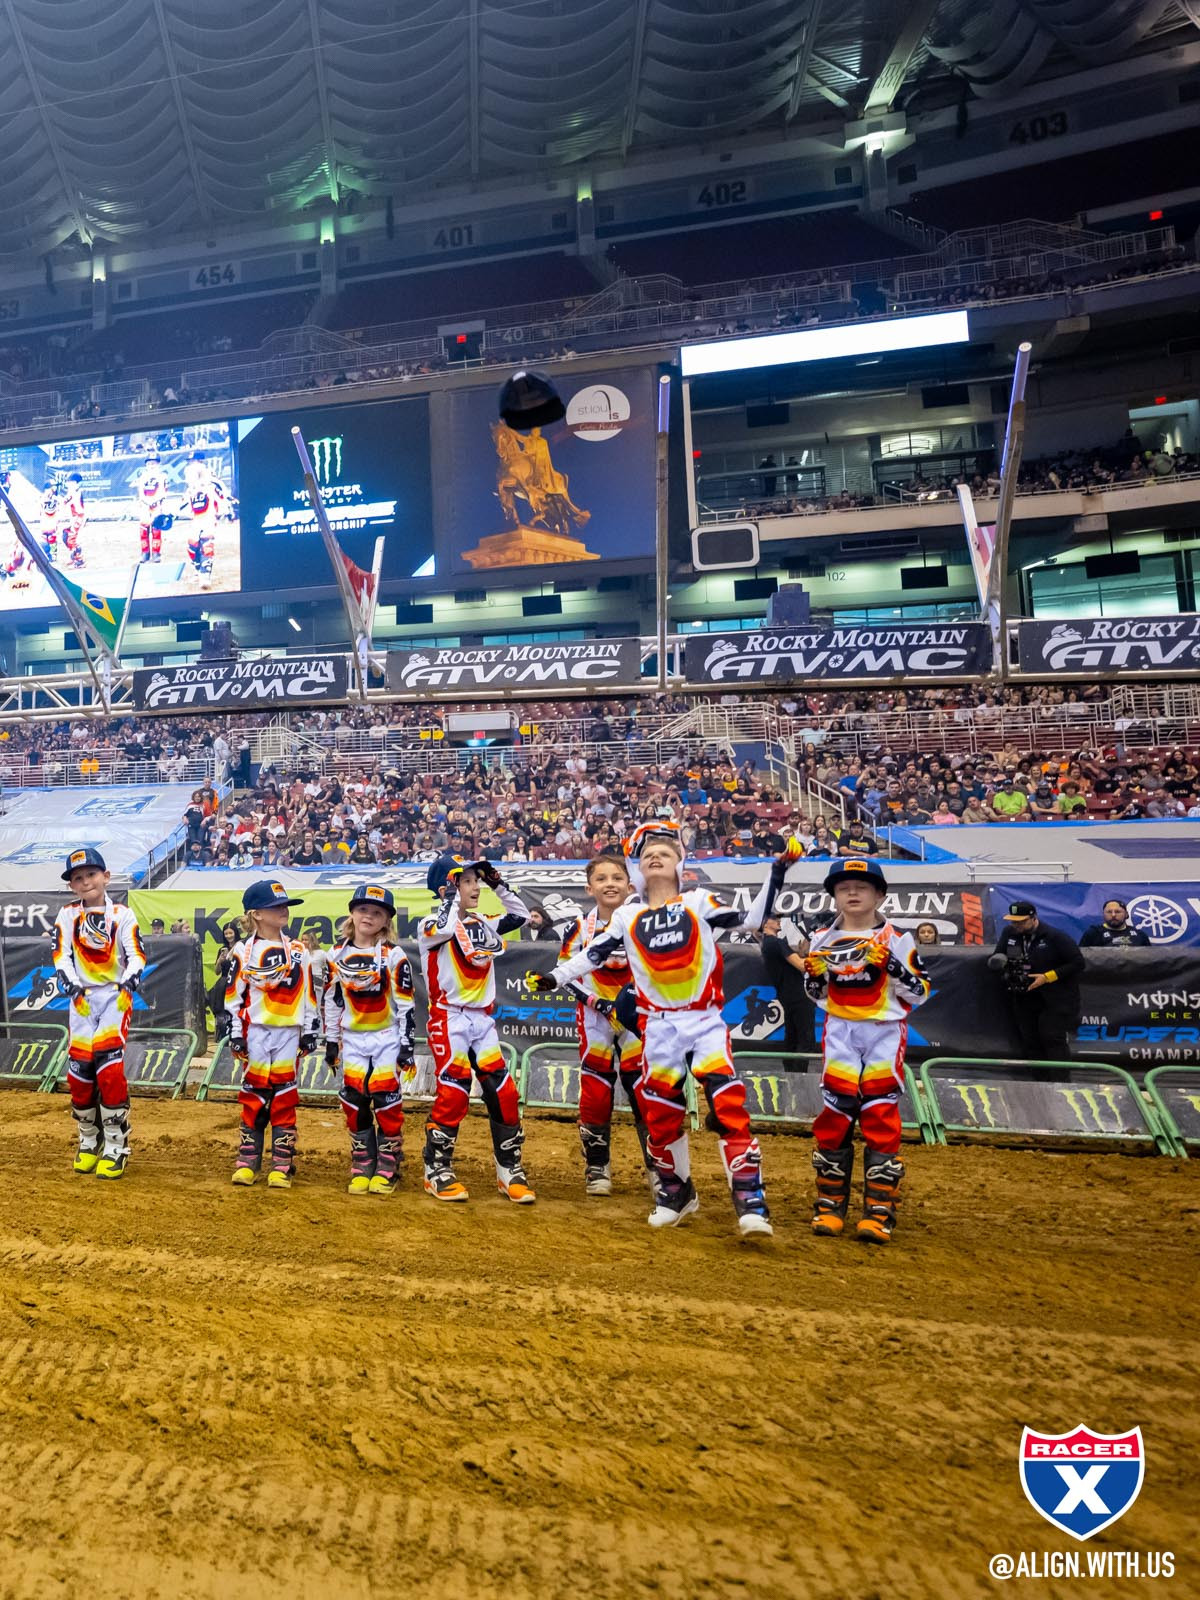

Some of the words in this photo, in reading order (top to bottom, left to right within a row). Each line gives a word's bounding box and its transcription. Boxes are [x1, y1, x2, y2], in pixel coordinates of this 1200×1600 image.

[1008, 112, 1068, 145] 403
[698, 181, 746, 207] 402
[434, 224, 473, 249] 401
[195, 263, 235, 287] 454
[293, 484, 362, 501] MNSTER
[827, 572, 846, 582] 102
[743, 634, 825, 652] ROCKY
[827, 629, 967, 648] MOUNTAIN
[1088, 621, 1186, 639] ROCKY
[434, 649, 502, 665] ROCKY
[505, 644, 622, 661] MOUNTAIN
[172, 667, 229, 683] ROCKY
[233, 661, 328, 678] MOUNTAIN
[731, 887, 954, 914] MOUAIN
[641, 912, 681, 932] TLD
[650, 931, 683, 948] KTM
[402, 964, 410, 989] TLD
[1081, 1016, 1109, 1025] AMA
[432, 1020, 446, 1057] TLD
